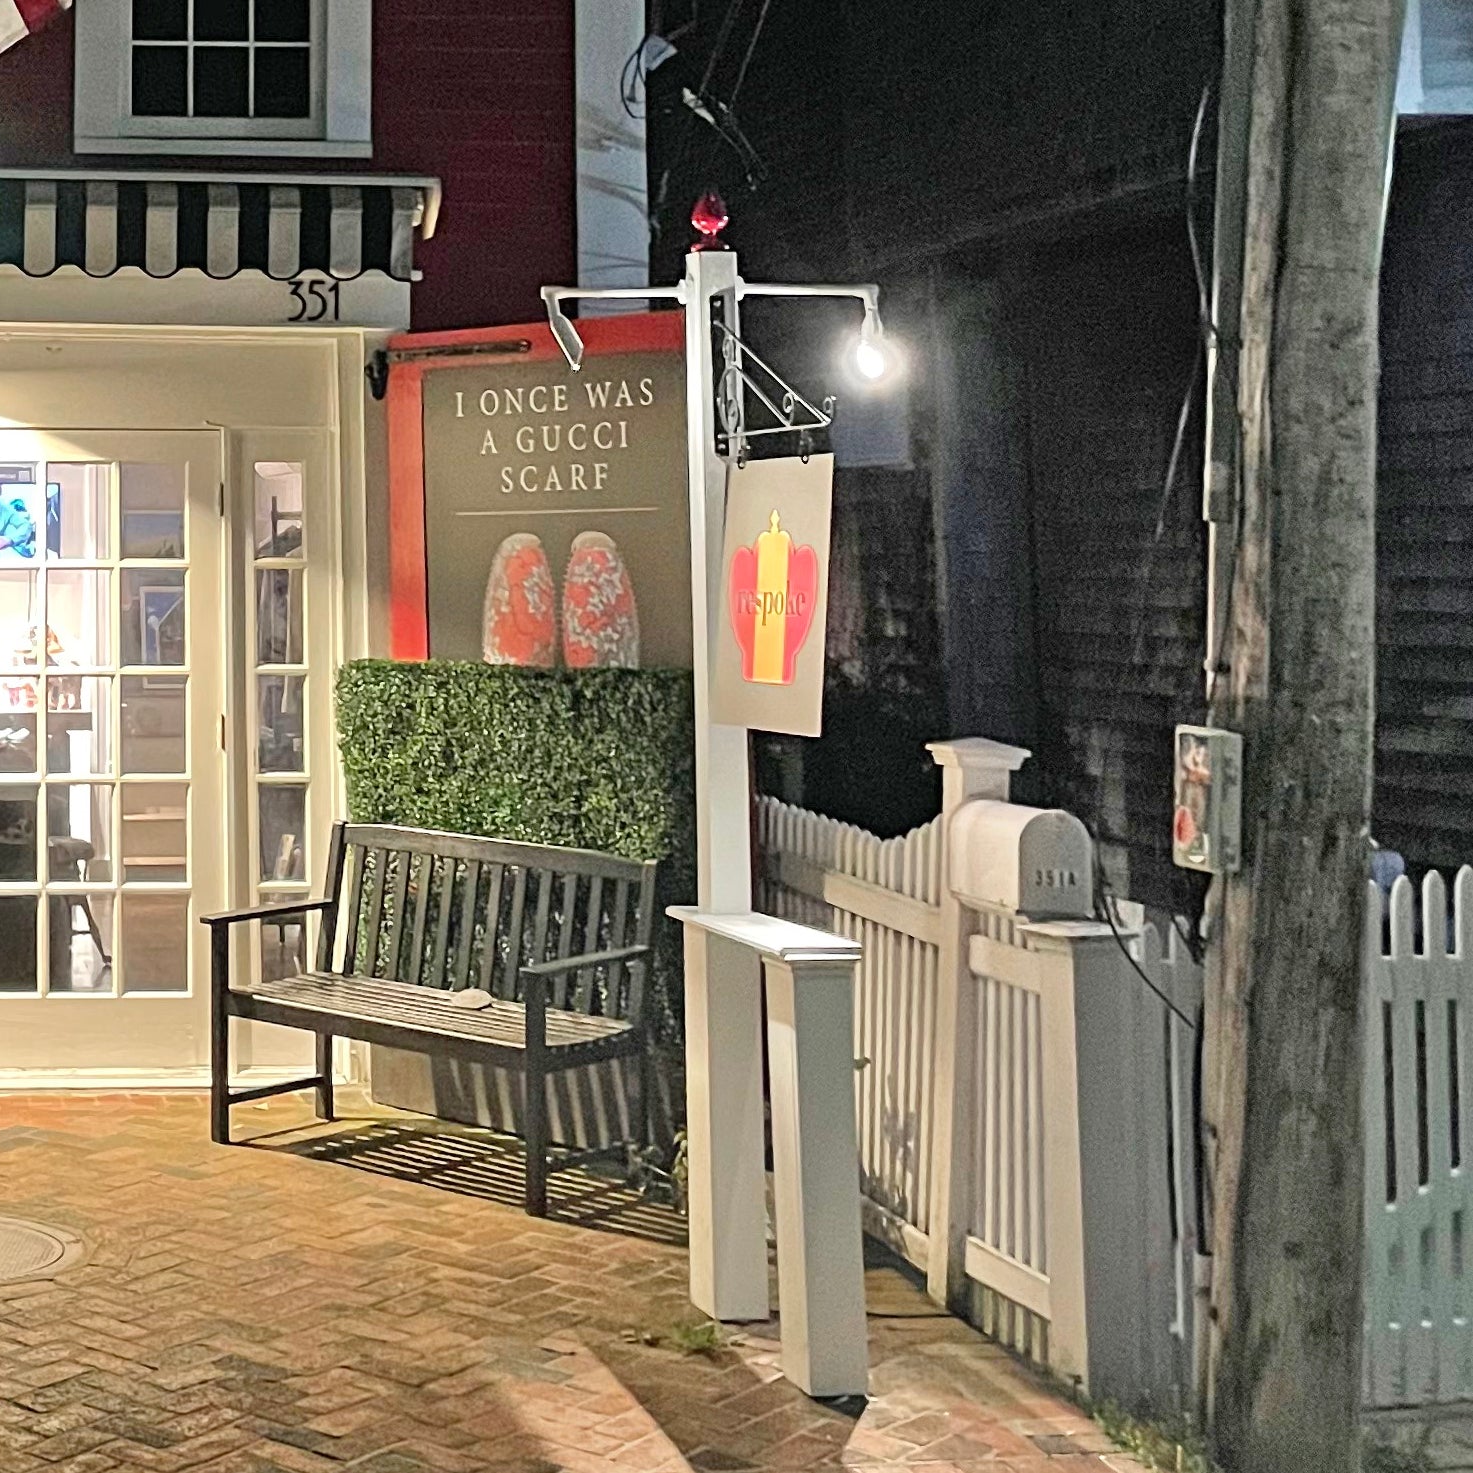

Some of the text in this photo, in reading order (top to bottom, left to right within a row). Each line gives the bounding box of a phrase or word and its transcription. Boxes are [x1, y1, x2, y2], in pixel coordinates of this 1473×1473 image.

[287, 279, 340, 322] 351
[455, 378, 654, 418] I ONCE WAS
[480, 421, 629, 455] A GUCCI
[500, 462, 609, 494] SCARF
[737, 580, 807, 626] respoke
[1035, 869, 1077, 888] 351A
